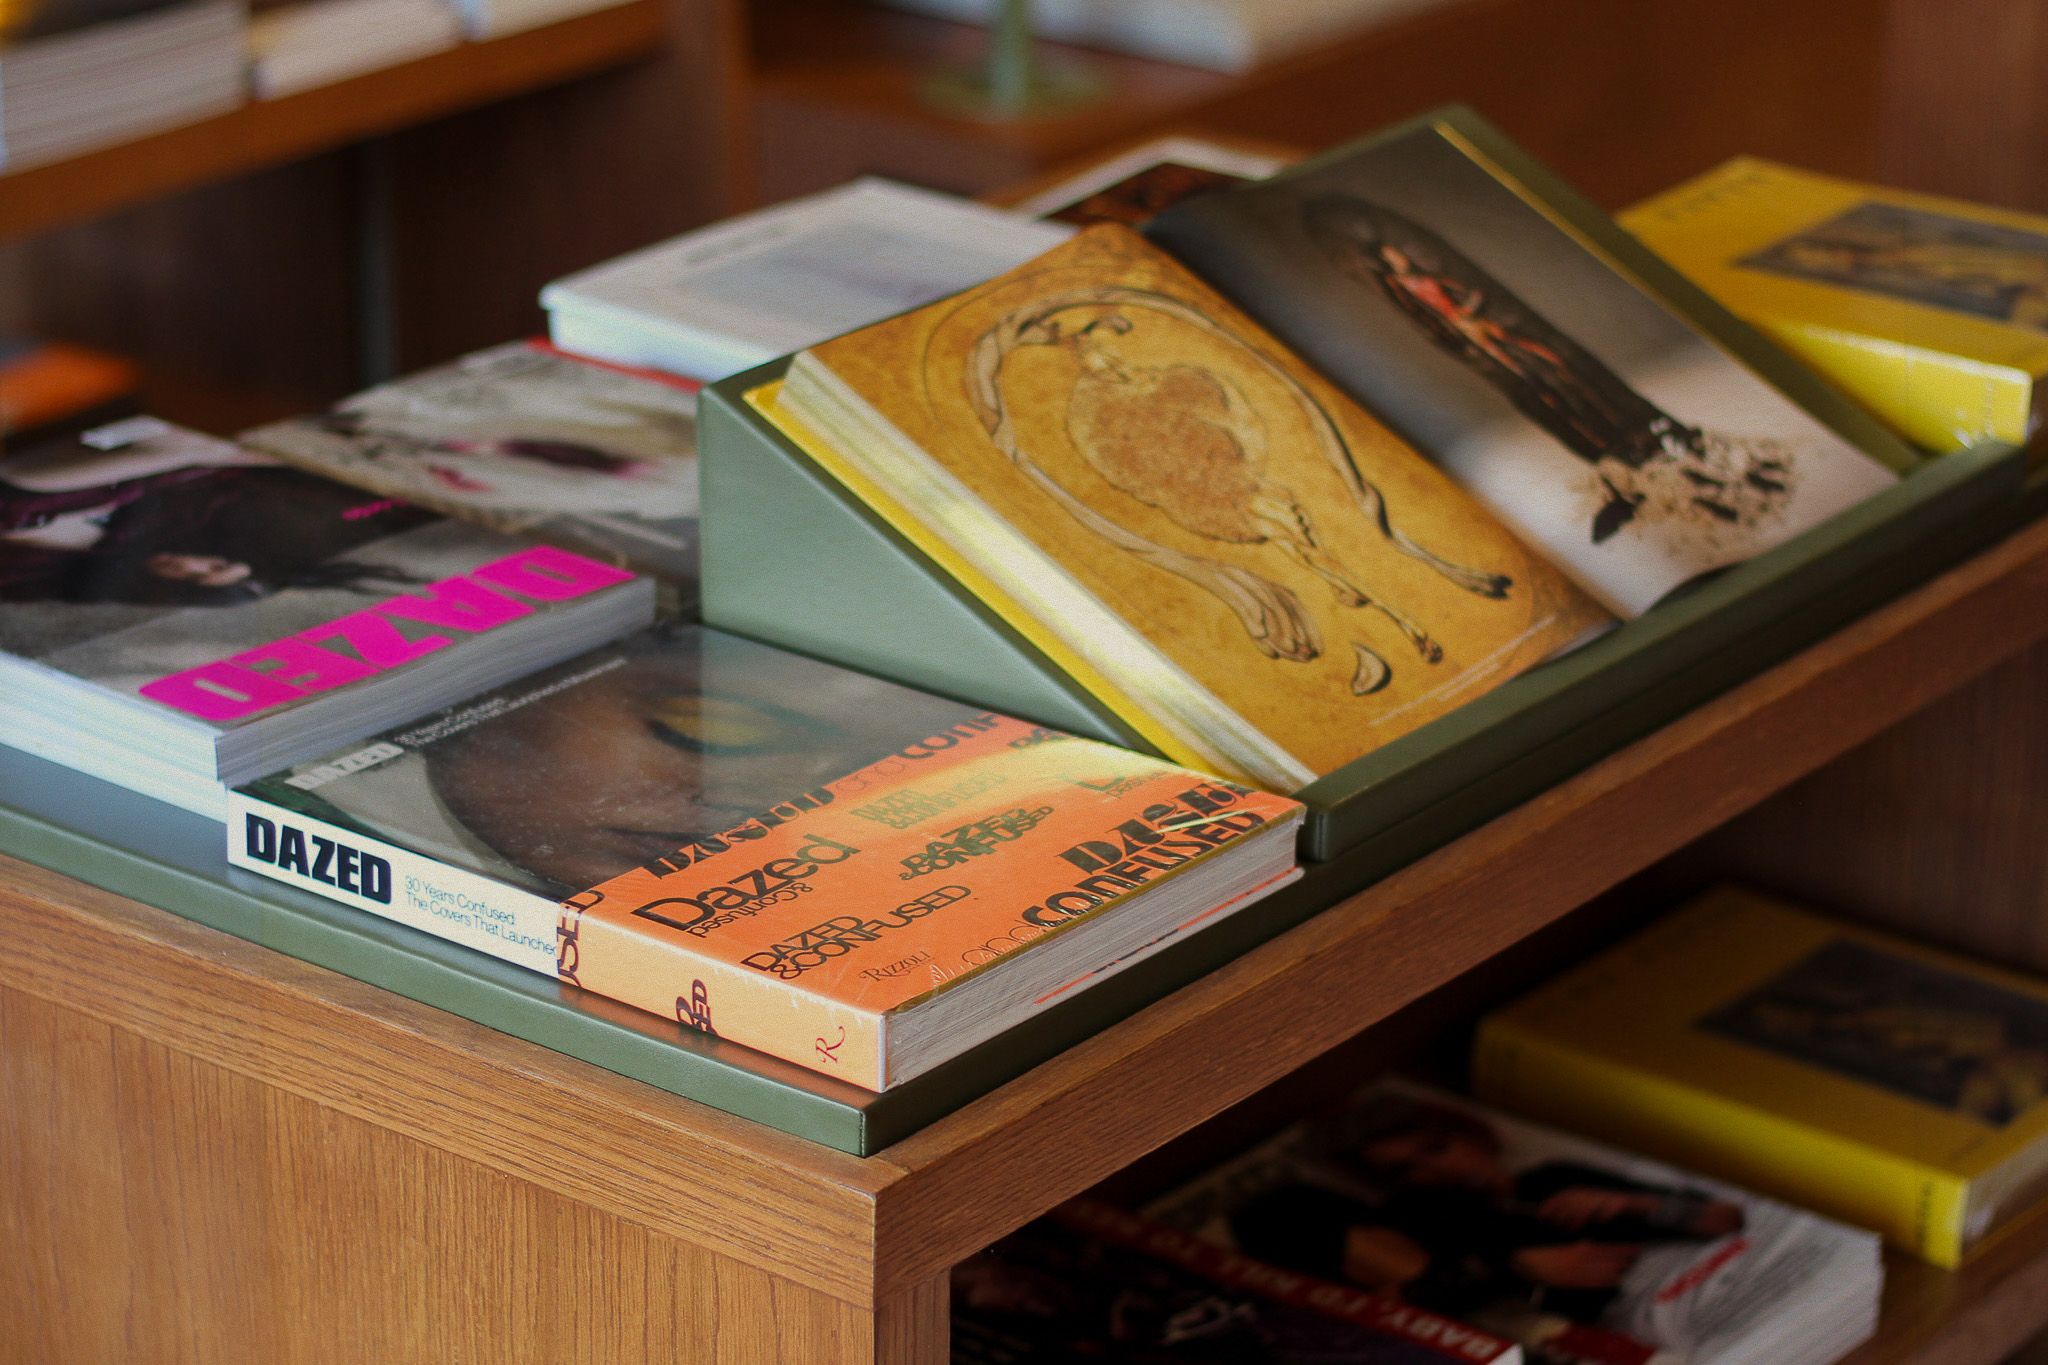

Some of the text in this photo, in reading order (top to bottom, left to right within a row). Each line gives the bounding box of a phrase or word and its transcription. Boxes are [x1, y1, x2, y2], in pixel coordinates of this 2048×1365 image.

[138, 545, 638, 721] DAZED
[245, 811, 392, 905] DAZED
[405, 874, 421, 893] 30
[422, 880, 455, 905] Years
[630, 833, 862, 932] Dazed
[406, 889, 429, 911] The
[429, 900, 472, 928] Covers
[473, 914, 500, 936] That
[740, 914, 864, 973] DAZED
